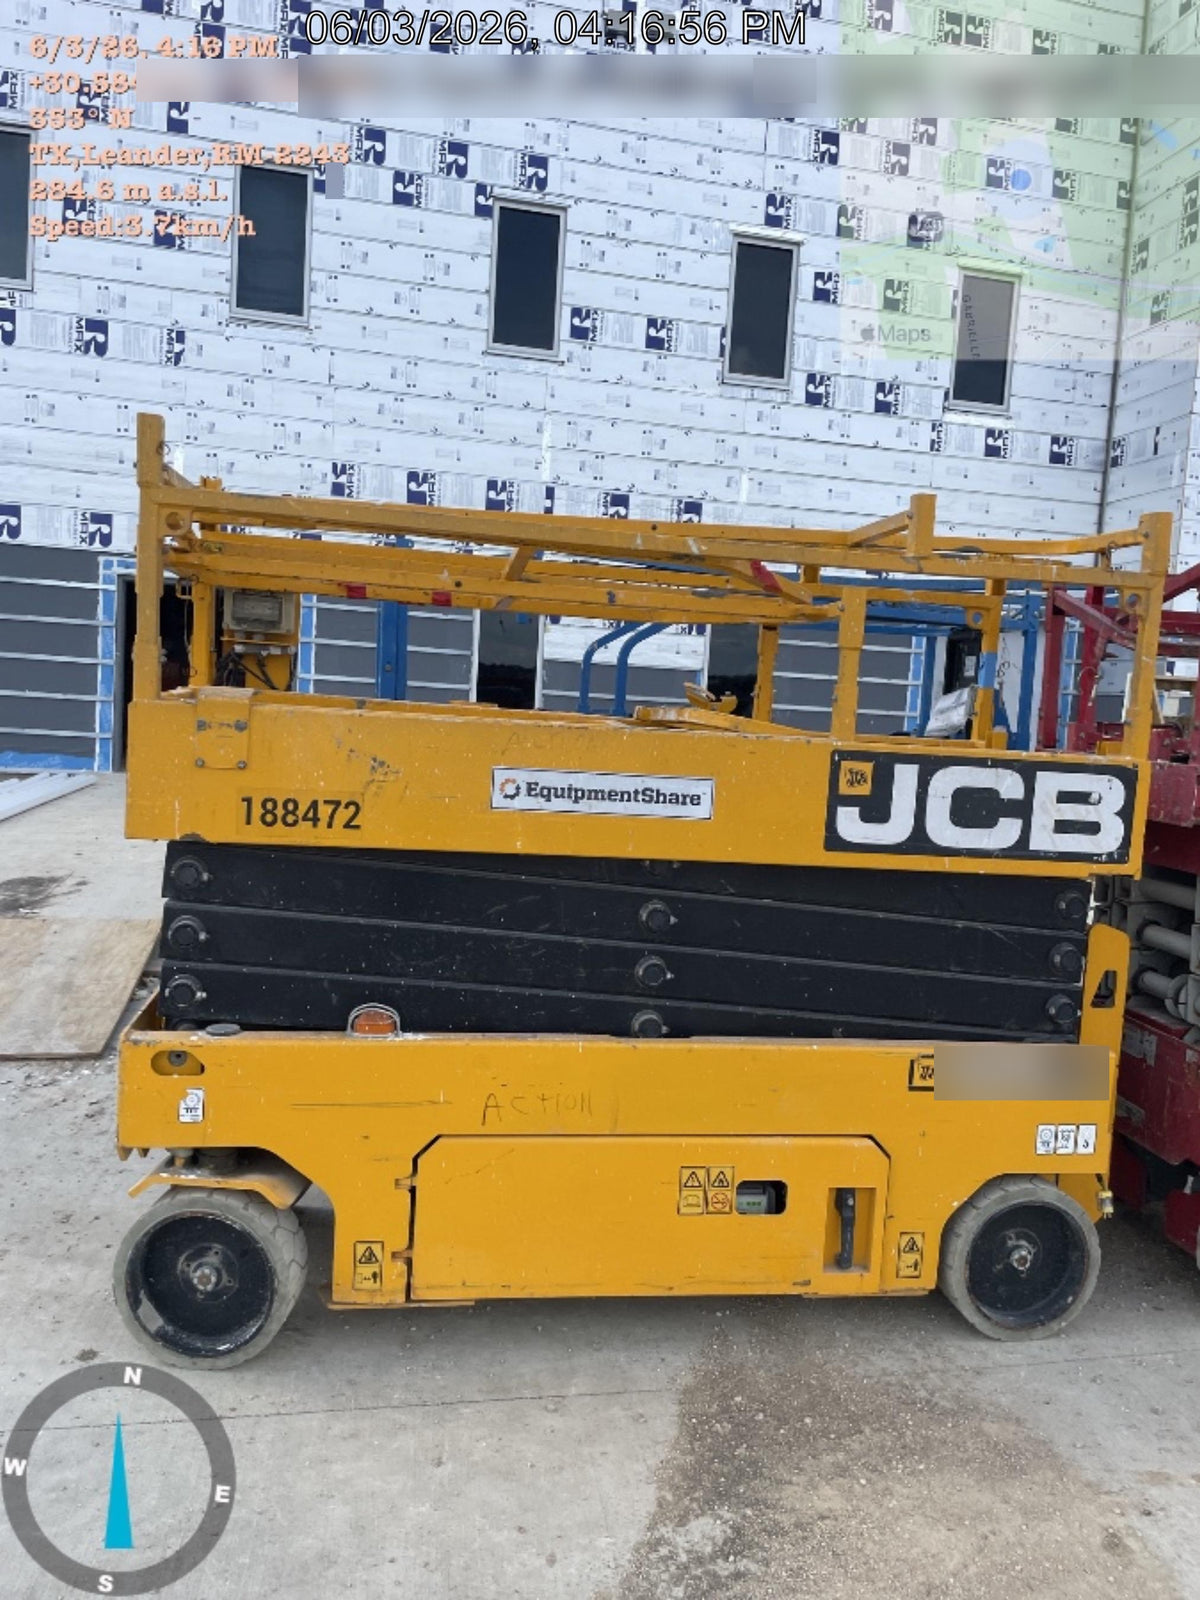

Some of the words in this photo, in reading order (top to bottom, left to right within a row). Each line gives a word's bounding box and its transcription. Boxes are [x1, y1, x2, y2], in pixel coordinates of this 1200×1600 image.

[524, 781, 702, 806] EquipmentShare
[836, 763, 1127, 854] JCB
[240, 796, 361, 830] 188472
